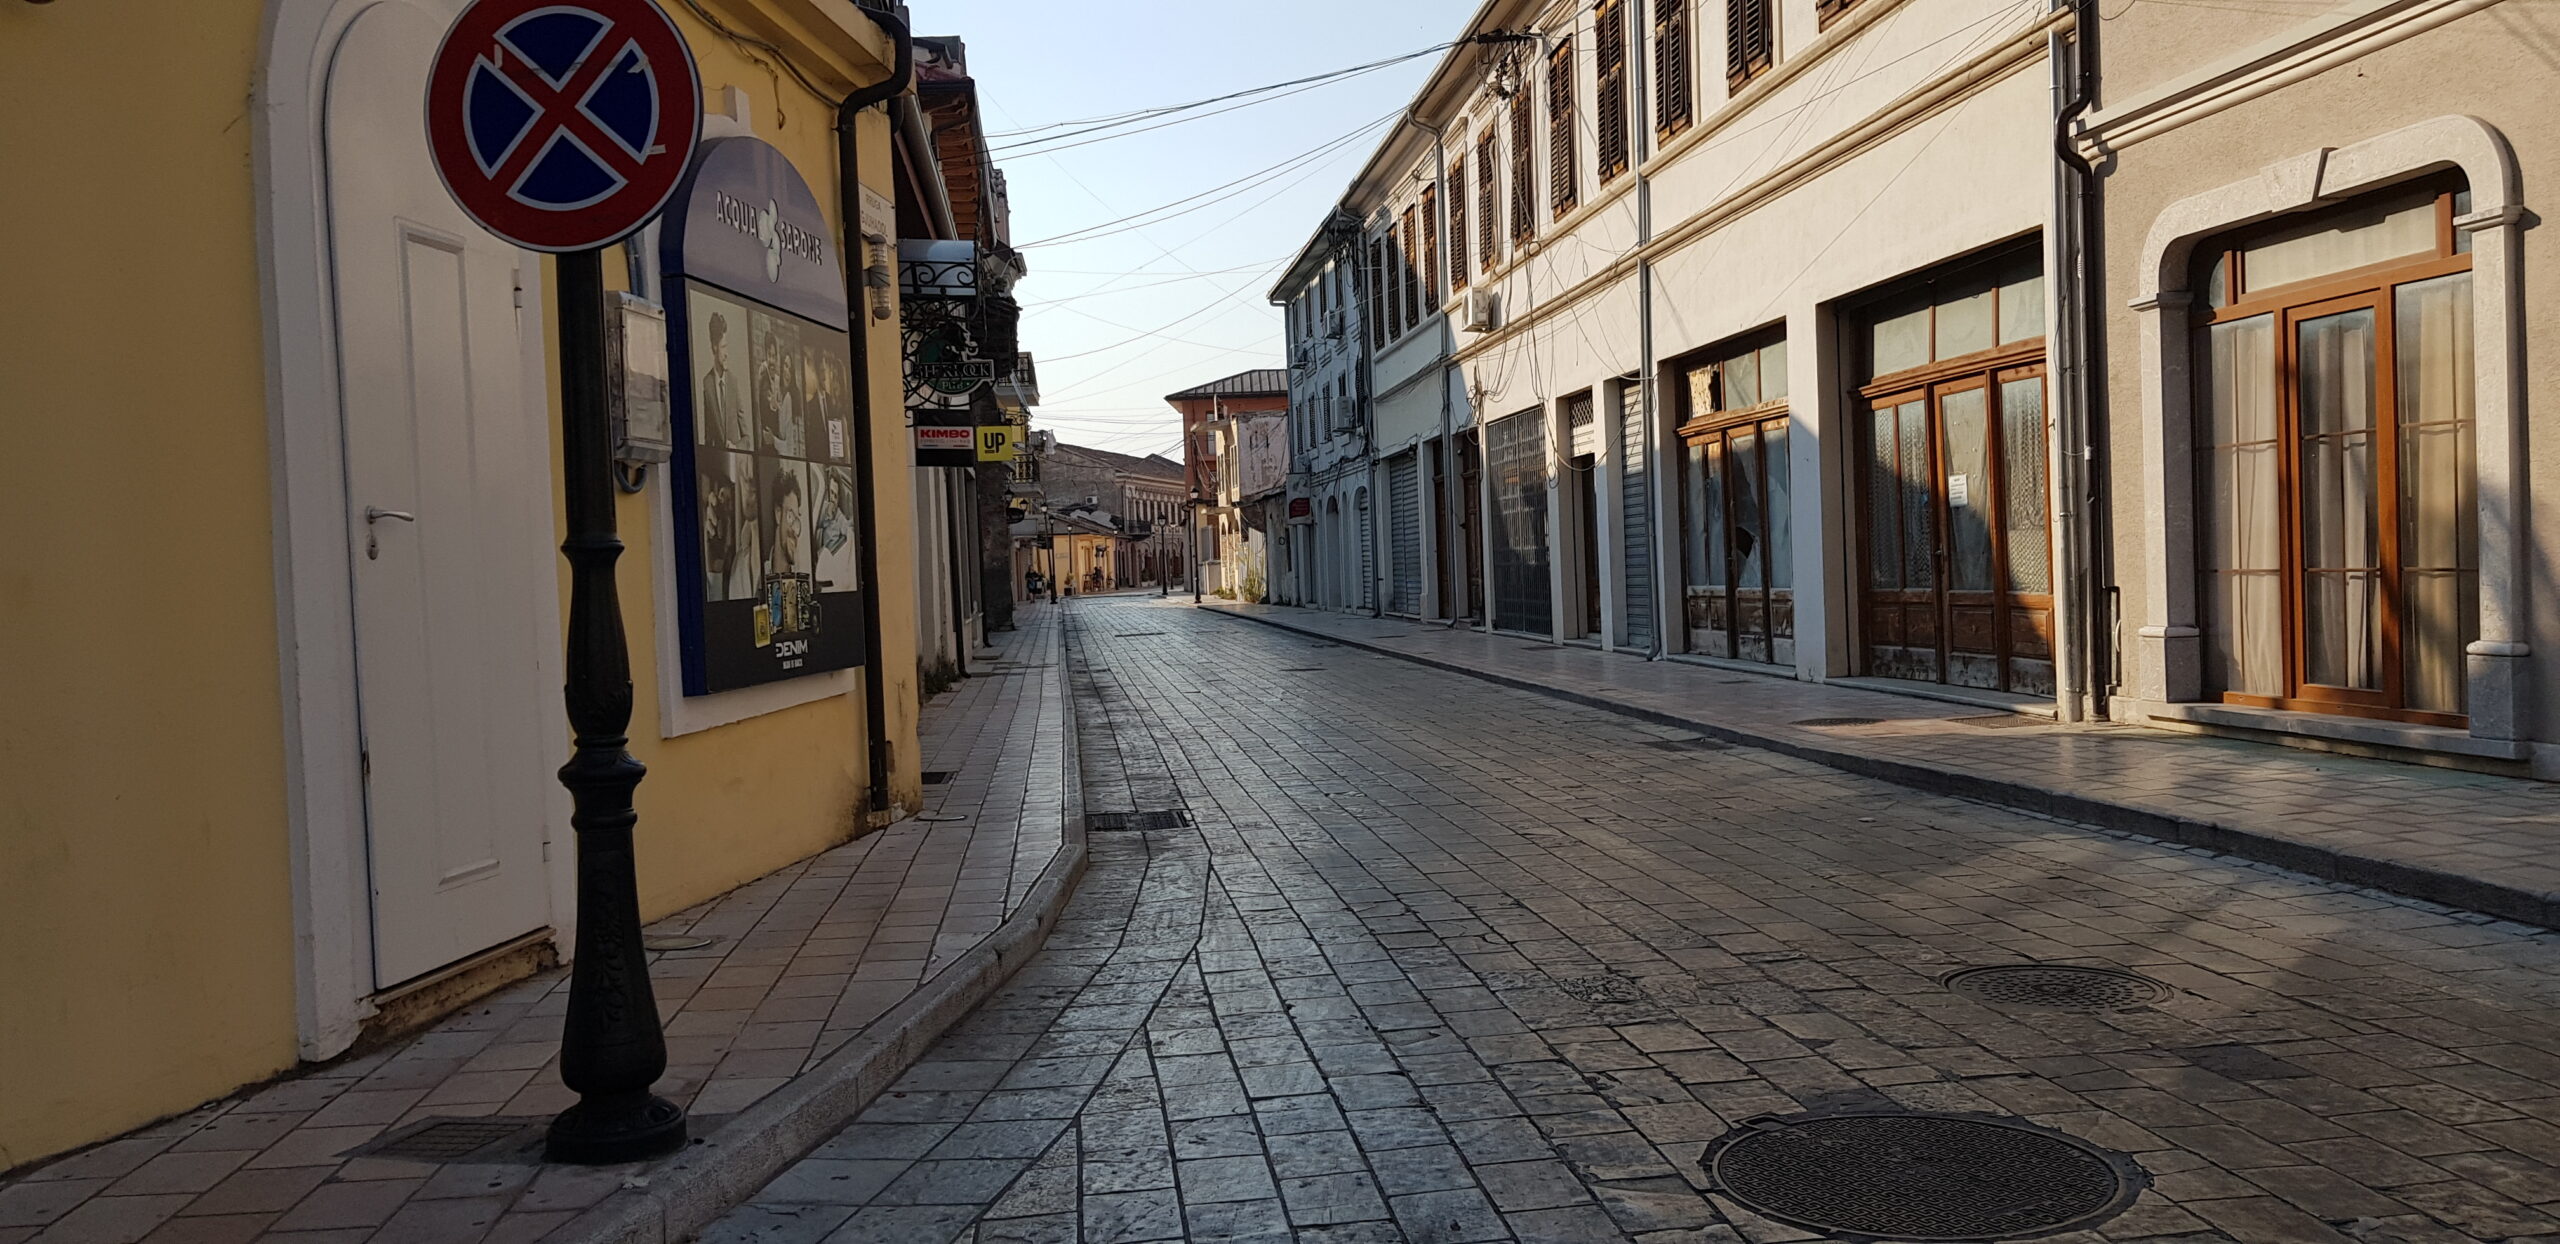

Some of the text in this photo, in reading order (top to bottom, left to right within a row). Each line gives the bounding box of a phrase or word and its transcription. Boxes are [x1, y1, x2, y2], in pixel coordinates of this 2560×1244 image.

[717, 190, 822, 266] ACQUA SAPONE
[920, 429, 970, 438] KIMBO
[984, 432, 1006, 453] UP
[776, 639, 808, 658] DENIM
